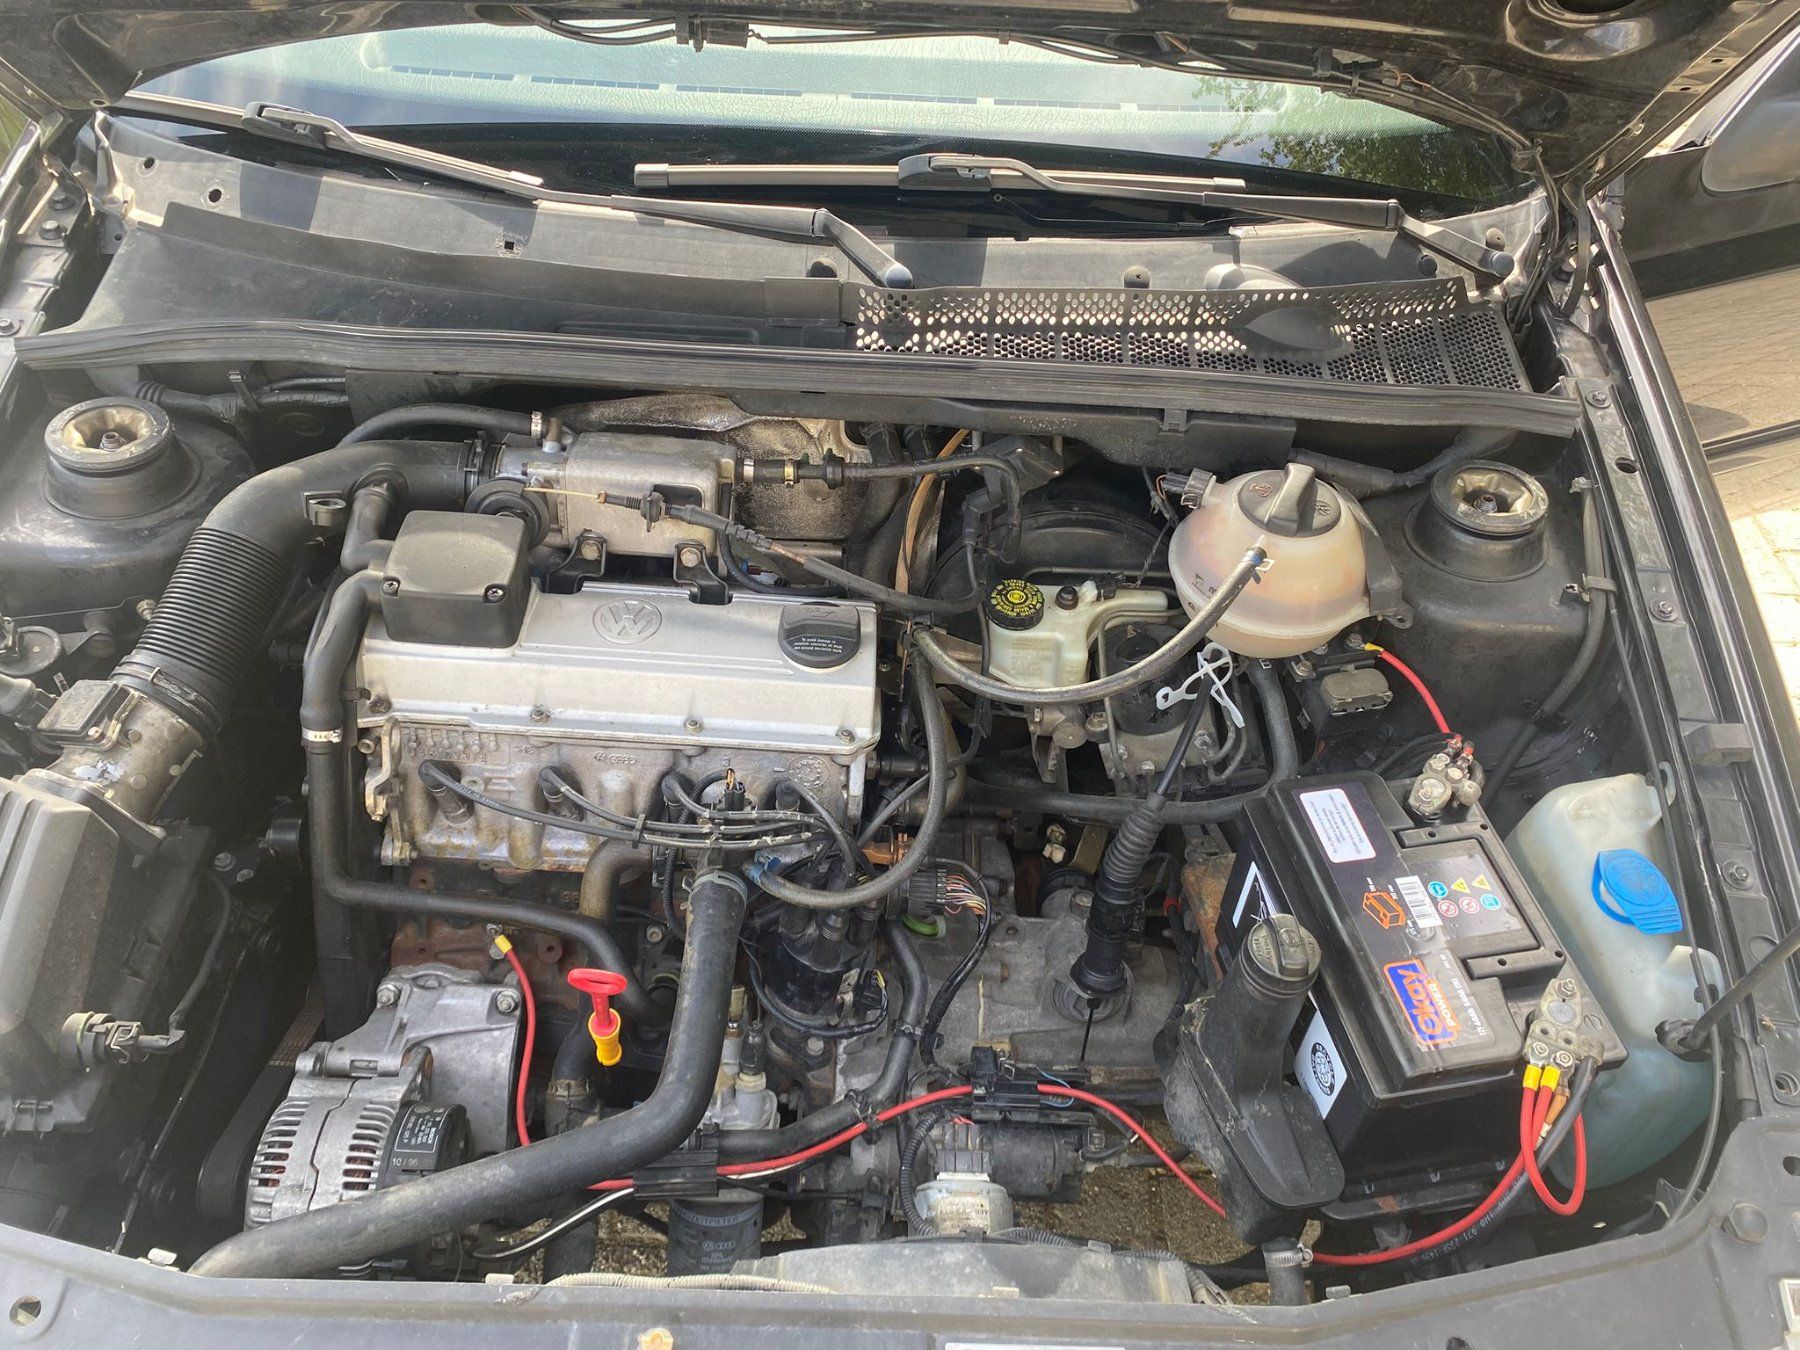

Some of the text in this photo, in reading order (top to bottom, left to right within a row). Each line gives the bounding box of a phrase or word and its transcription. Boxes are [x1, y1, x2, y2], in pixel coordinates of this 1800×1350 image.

[593, 600, 662, 645] VW
[1397, 967, 1444, 1035] Okay
[1428, 982, 1457, 1027] POWER
[392, 1158, 402, 1166] 10
